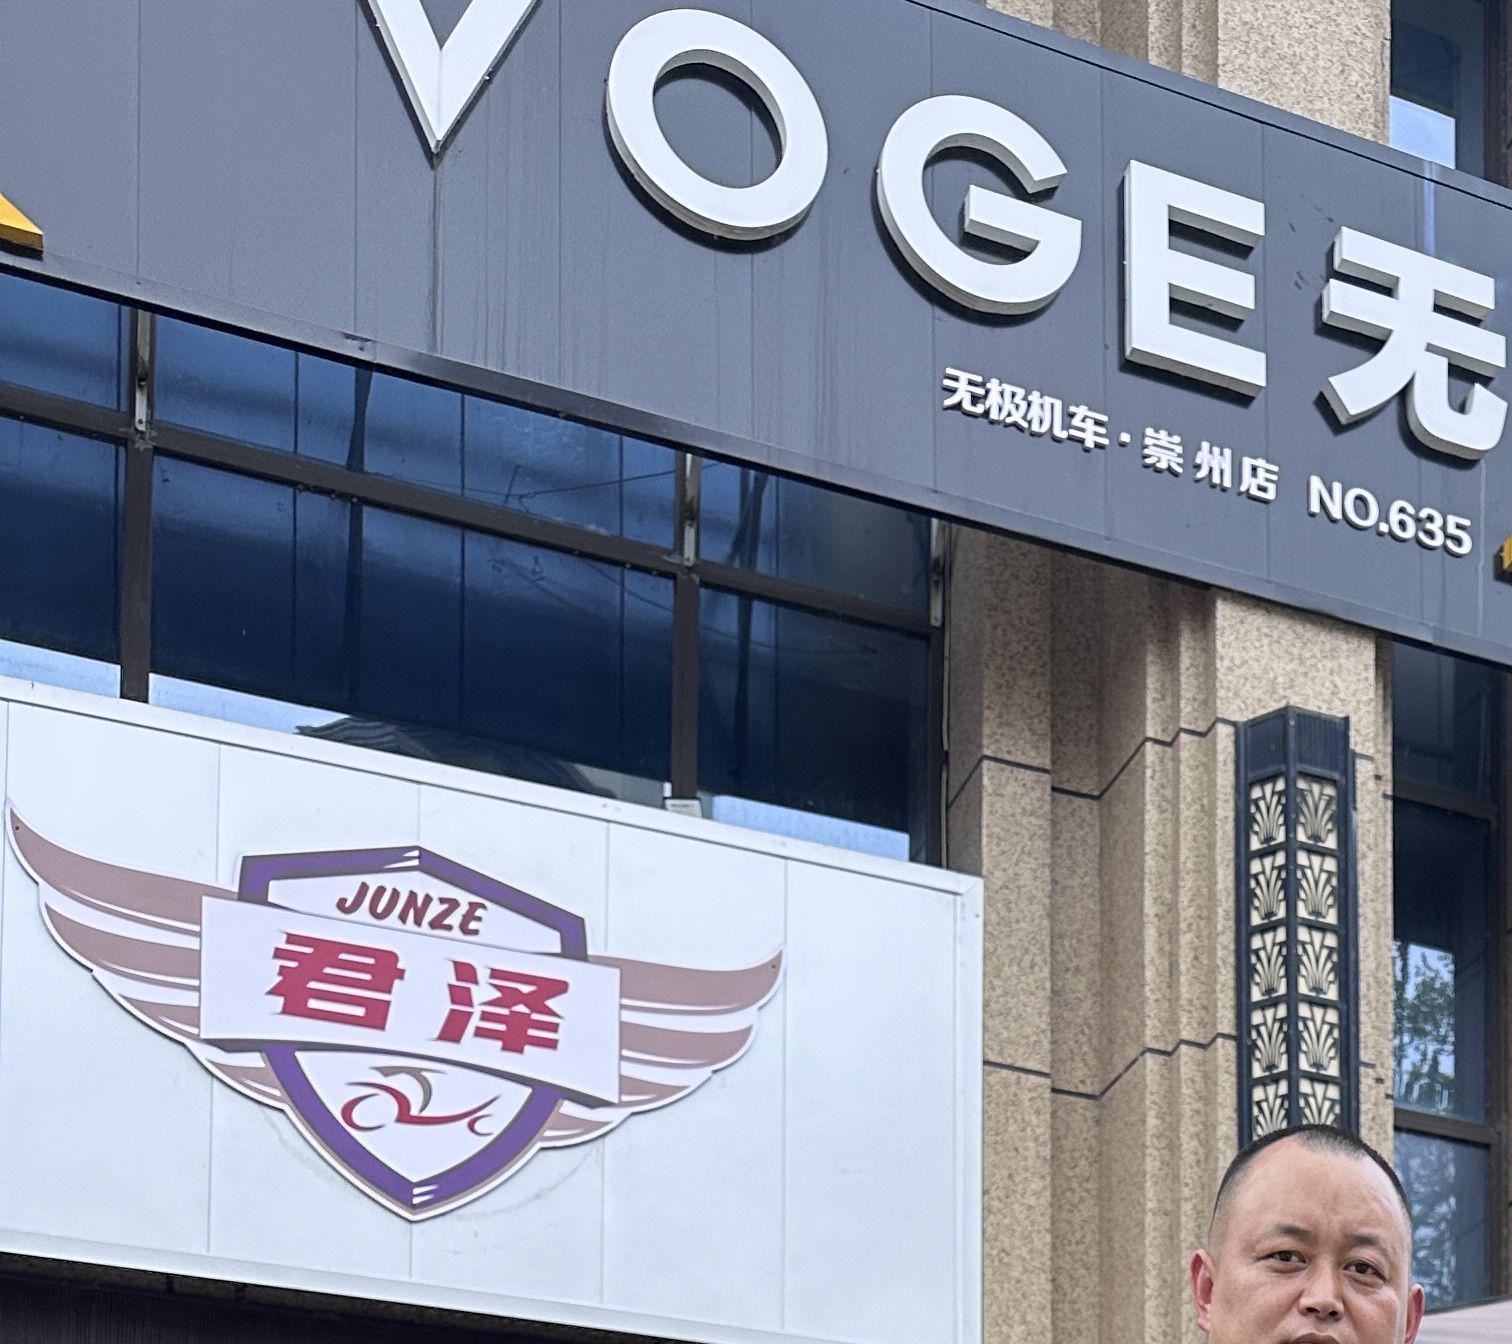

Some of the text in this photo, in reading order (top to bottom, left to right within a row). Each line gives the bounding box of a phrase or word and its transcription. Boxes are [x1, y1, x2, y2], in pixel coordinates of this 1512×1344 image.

[1308, 475, 1473, 557] NO.635
[335, 880, 490, 938] JUNZE
[262, 931, 571, 1056] 君泽
